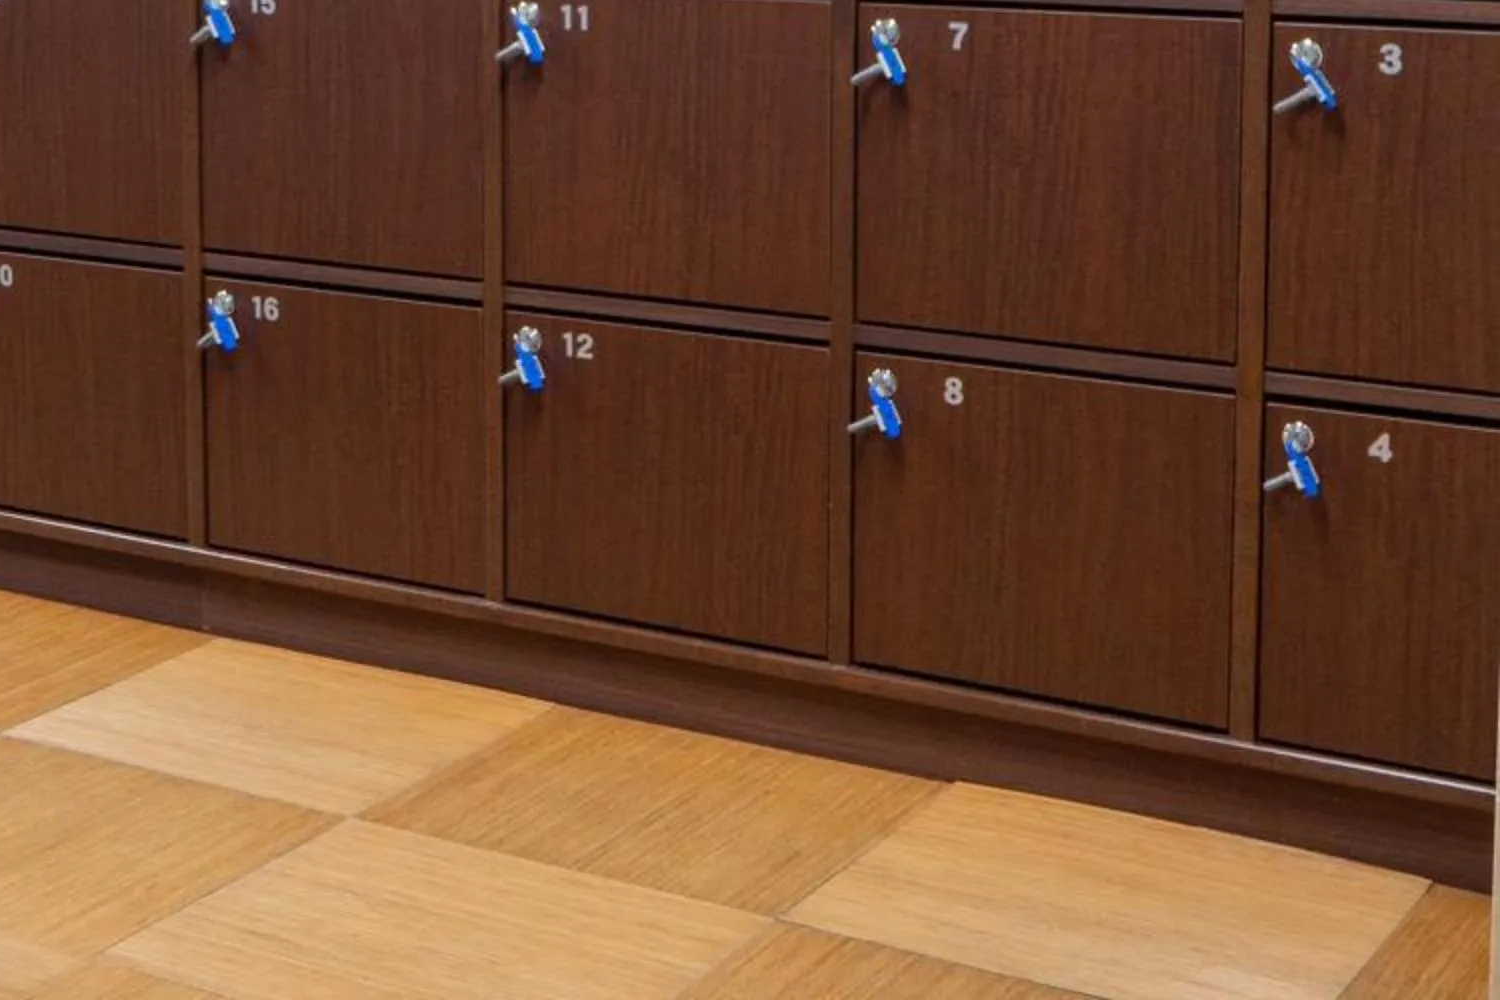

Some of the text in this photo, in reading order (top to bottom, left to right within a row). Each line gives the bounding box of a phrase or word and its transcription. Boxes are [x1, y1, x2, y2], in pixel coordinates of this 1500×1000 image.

[560, 4, 589, 31] 11
[948, 21, 969, 51] 7
[1378, 43, 1403, 76] 3
[251, 295, 280, 321] 16
[562, 331, 594, 360] 12
[943, 376, 964, 406] 8
[1367, 432, 1393, 463] 4
